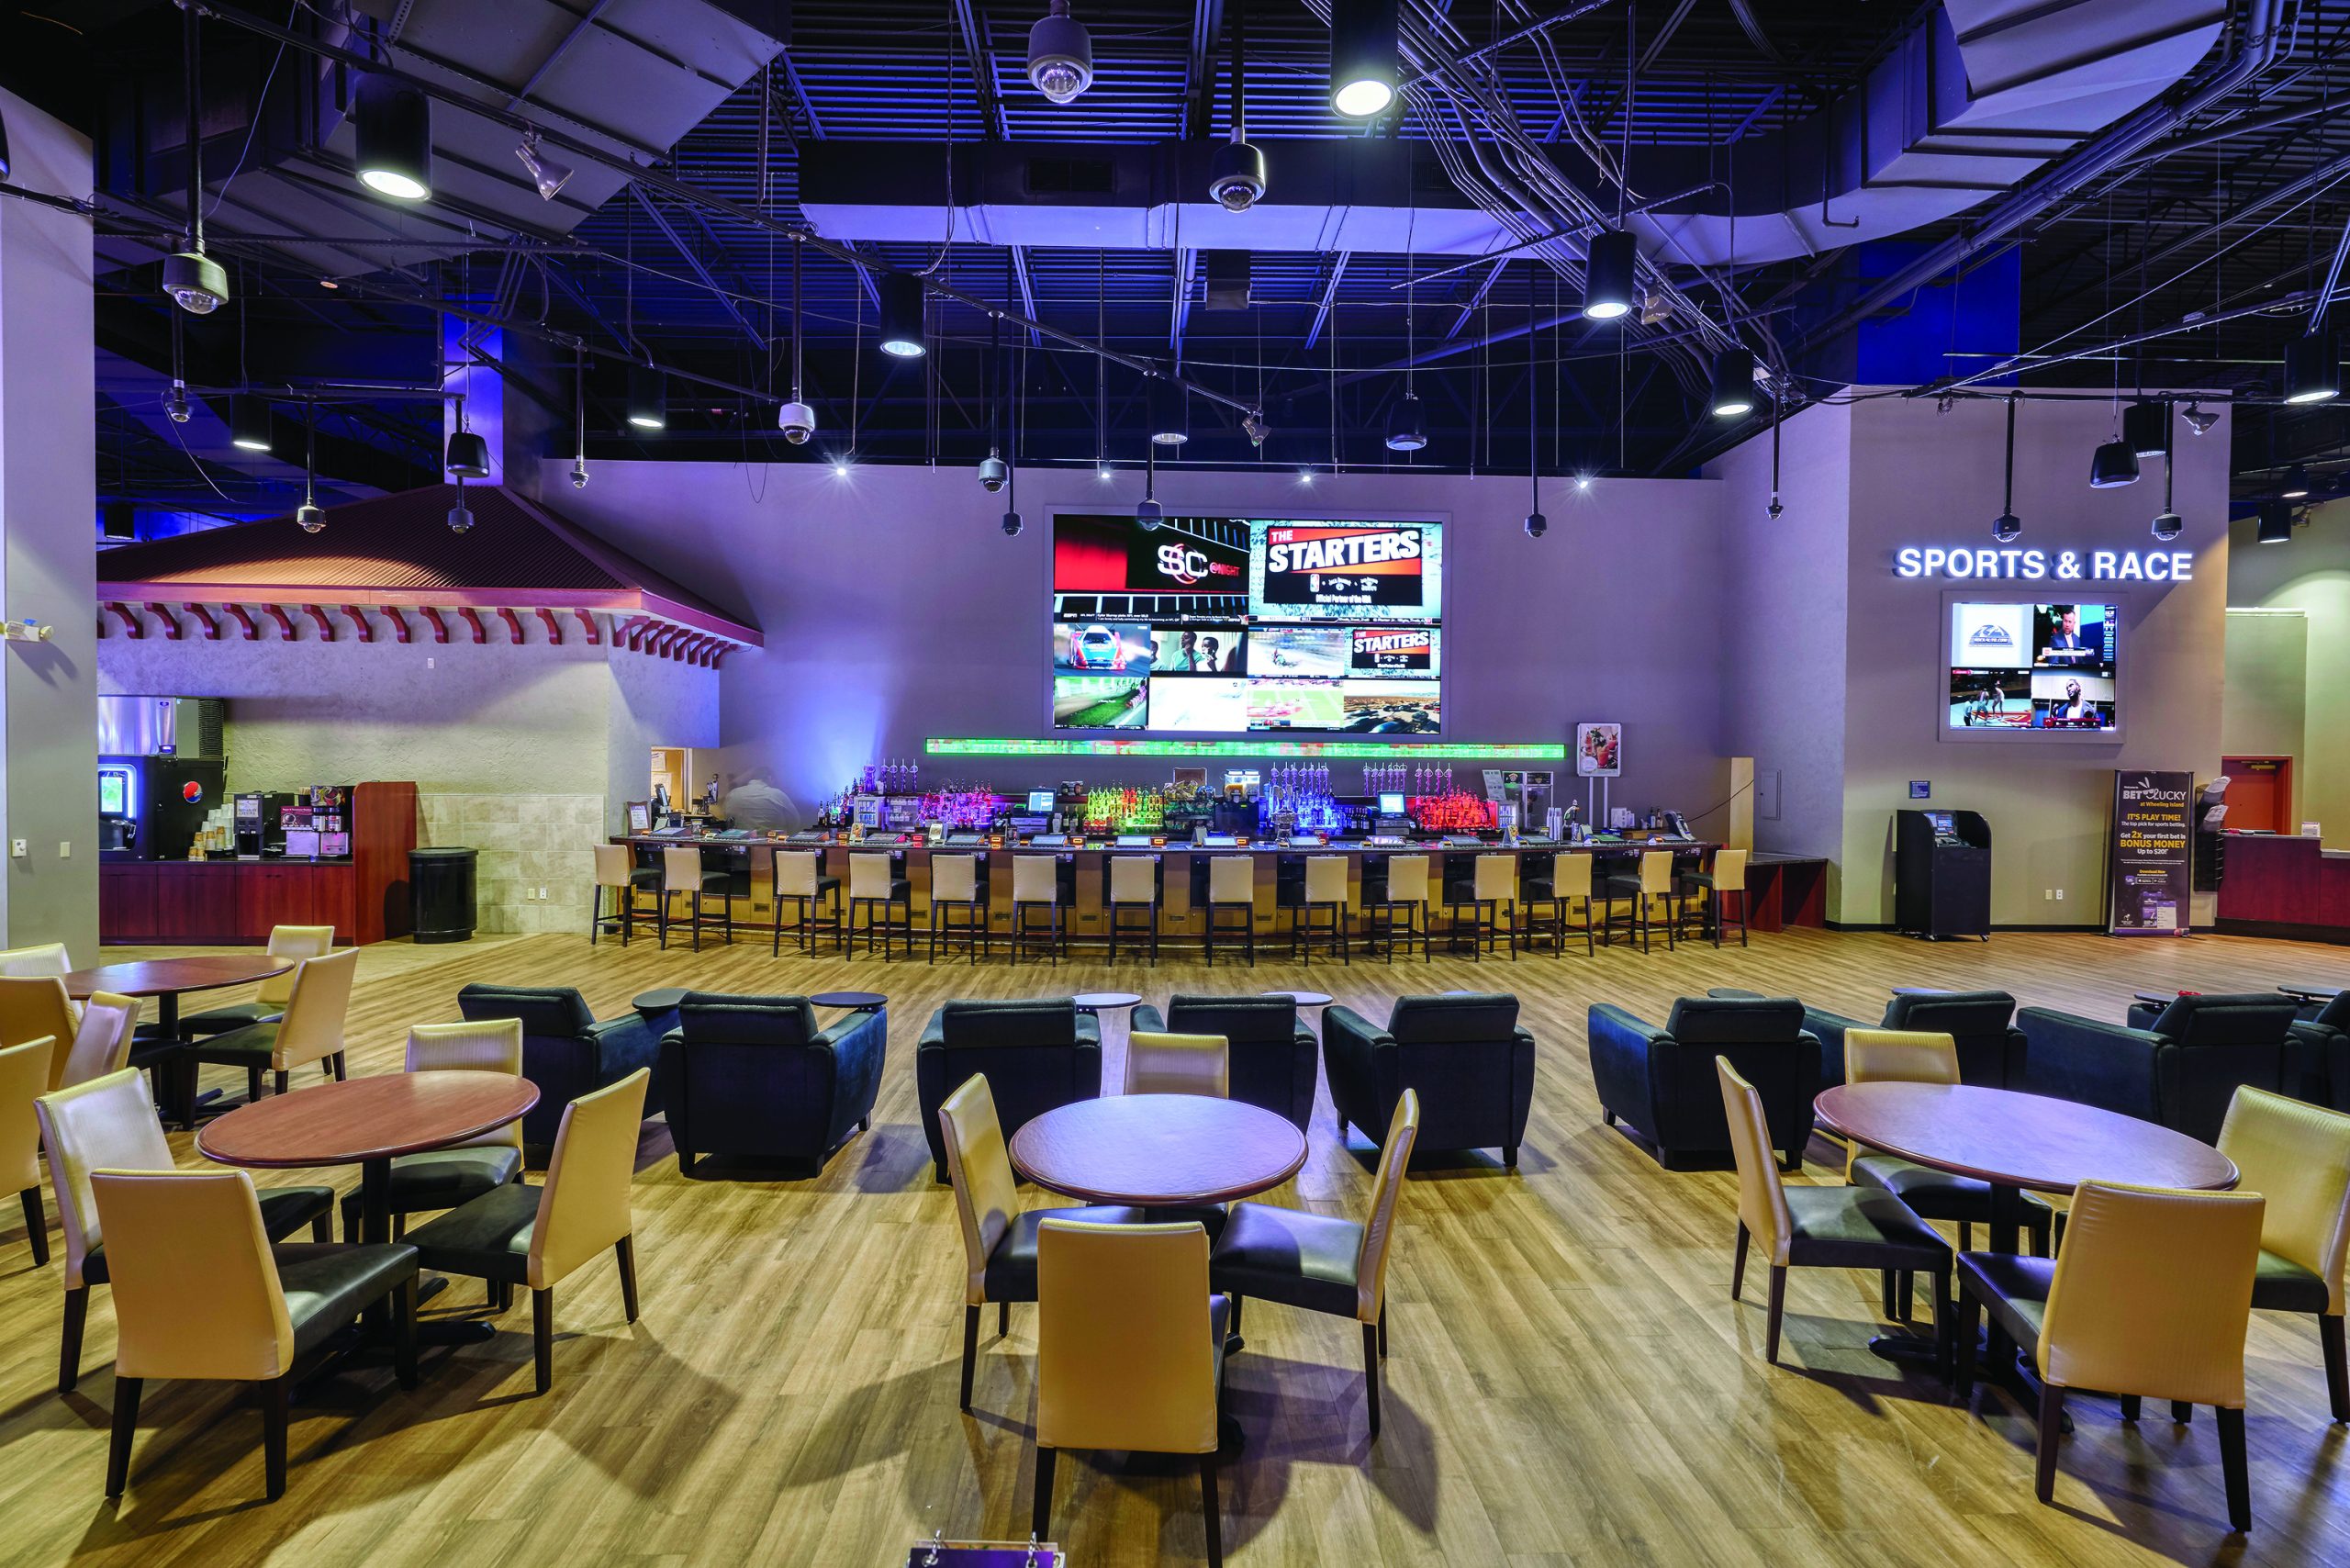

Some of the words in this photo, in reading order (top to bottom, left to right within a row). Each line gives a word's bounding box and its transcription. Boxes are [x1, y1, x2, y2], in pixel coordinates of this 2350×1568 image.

[1271, 530, 1293, 542] THE
[1269, 530, 1421, 573] STARTERS
[1157, 544, 1208, 577] SC
[1898, 548, 2045, 579] SPORTS
[2057, 551, 2082, 579] &
[2093, 552, 2193, 580] RACE
[1353, 632, 1430, 654] STARTERS
[2123, 790, 2143, 800] BET
[2132, 830, 2143, 839] 2x
[2120, 839, 2152, 848] BONUS
[2153, 840, 2186, 848] MONEY
